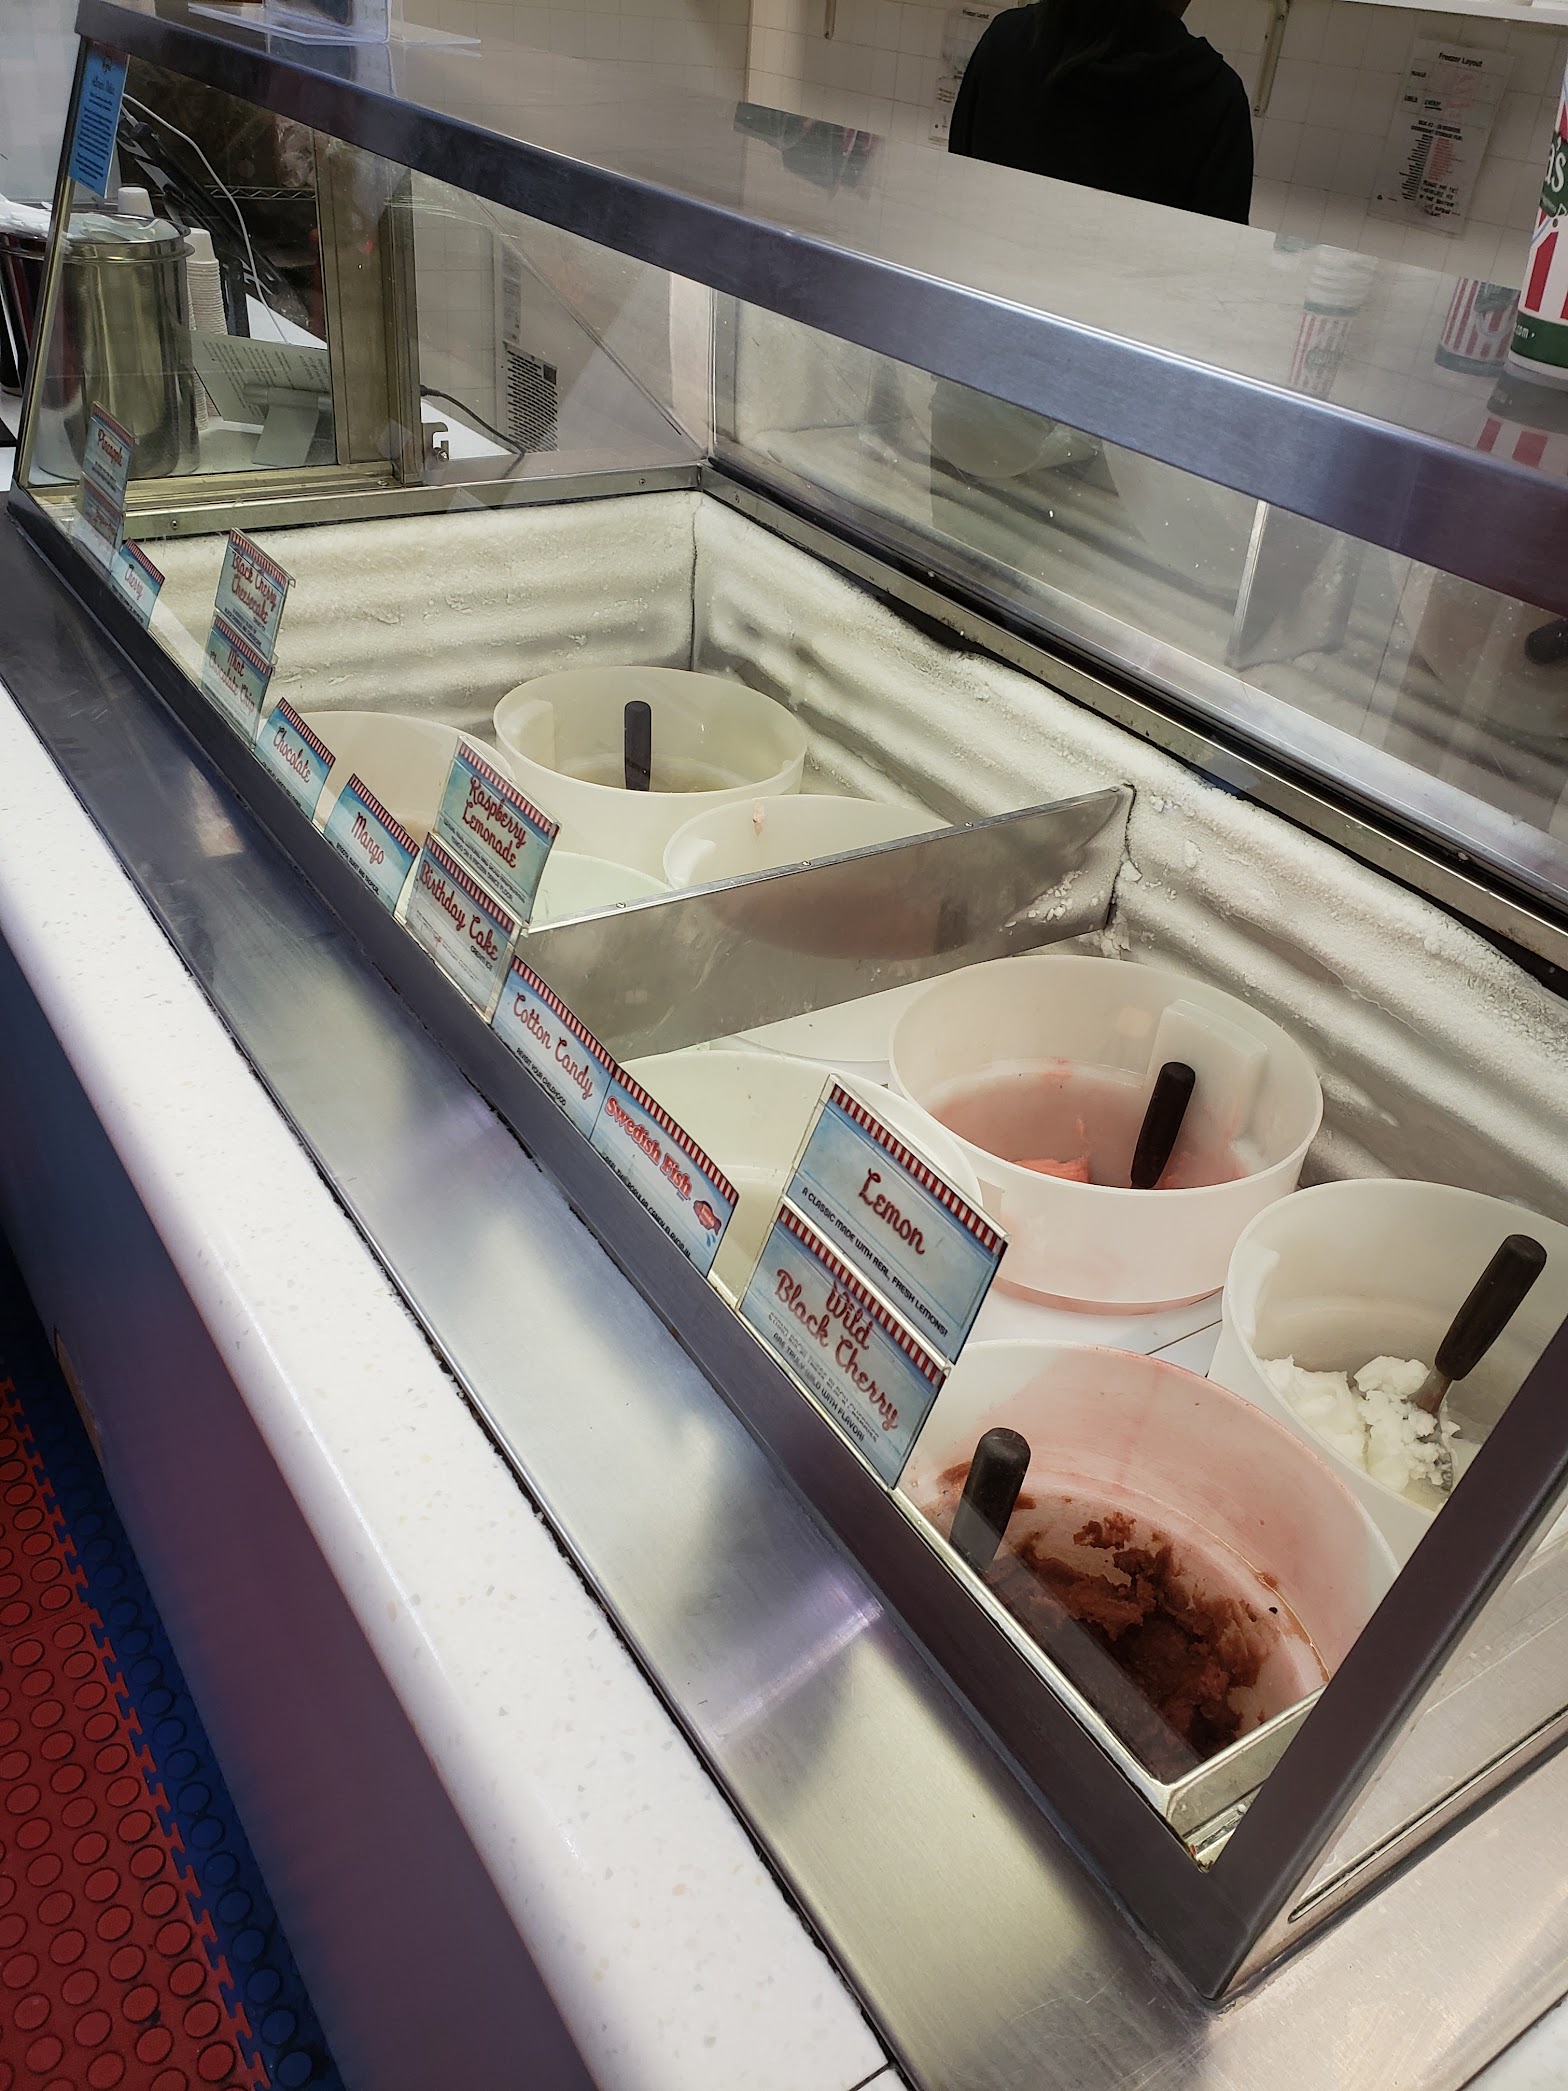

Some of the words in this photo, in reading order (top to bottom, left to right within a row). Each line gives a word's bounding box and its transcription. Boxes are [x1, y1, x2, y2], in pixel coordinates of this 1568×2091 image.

[1438, 52, 1461, 64] Freezer
[1461, 57, 1483, 68] Layout
[124, 563, 145, 600] Cherry
[231, 547, 257, 584] Black
[255, 566, 279, 612] Cherry
[231, 575, 268, 625] Cheesecake
[209, 650, 241, 696] Chocolate
[239, 681, 256, 711] Chip
[228, 648, 245, 677] Mint
[273, 726, 310, 783] Chocolate
[351, 811, 384, 865] Mango
[462, 800, 517, 868] Lemonade
[469, 776, 527, 849] Raspberry
[419, 861, 466, 931] Birthday
[469, 914, 498, 961] Cake
[514, 992, 551, 1049] Cotton
[555, 1036, 593, 1100] Candy
[531, 1064, 543, 1080] YOUR
[542, 1077, 566, 1106] CHILDHOOD
[605, 1096, 661, 1166] Swedish
[660, 1153, 692, 1199] Fish
[858, 1168, 925, 1255] Lemon
[802, 1187, 808, 1196] A
[808, 1193, 836, 1222] CLASSIC
[835, 1219, 856, 1242] MADE
[855, 1238, 873, 1260] WITH
[871, 1256, 892, 1281] REAL,
[891, 1276, 915, 1303] FRESH
[915, 1300, 948, 1337] LEMONS!
[826, 1280, 870, 1350] Wild
[775, 1269, 830, 1347] Black
[835, 1335, 899, 1431] Cherry
[773, 1333, 785, 1349] ARE
[786, 1346, 805, 1370] TRULY
[821, 1388, 838, 1410] WITH
[837, 1407, 864, 1442] FLAVOR!
